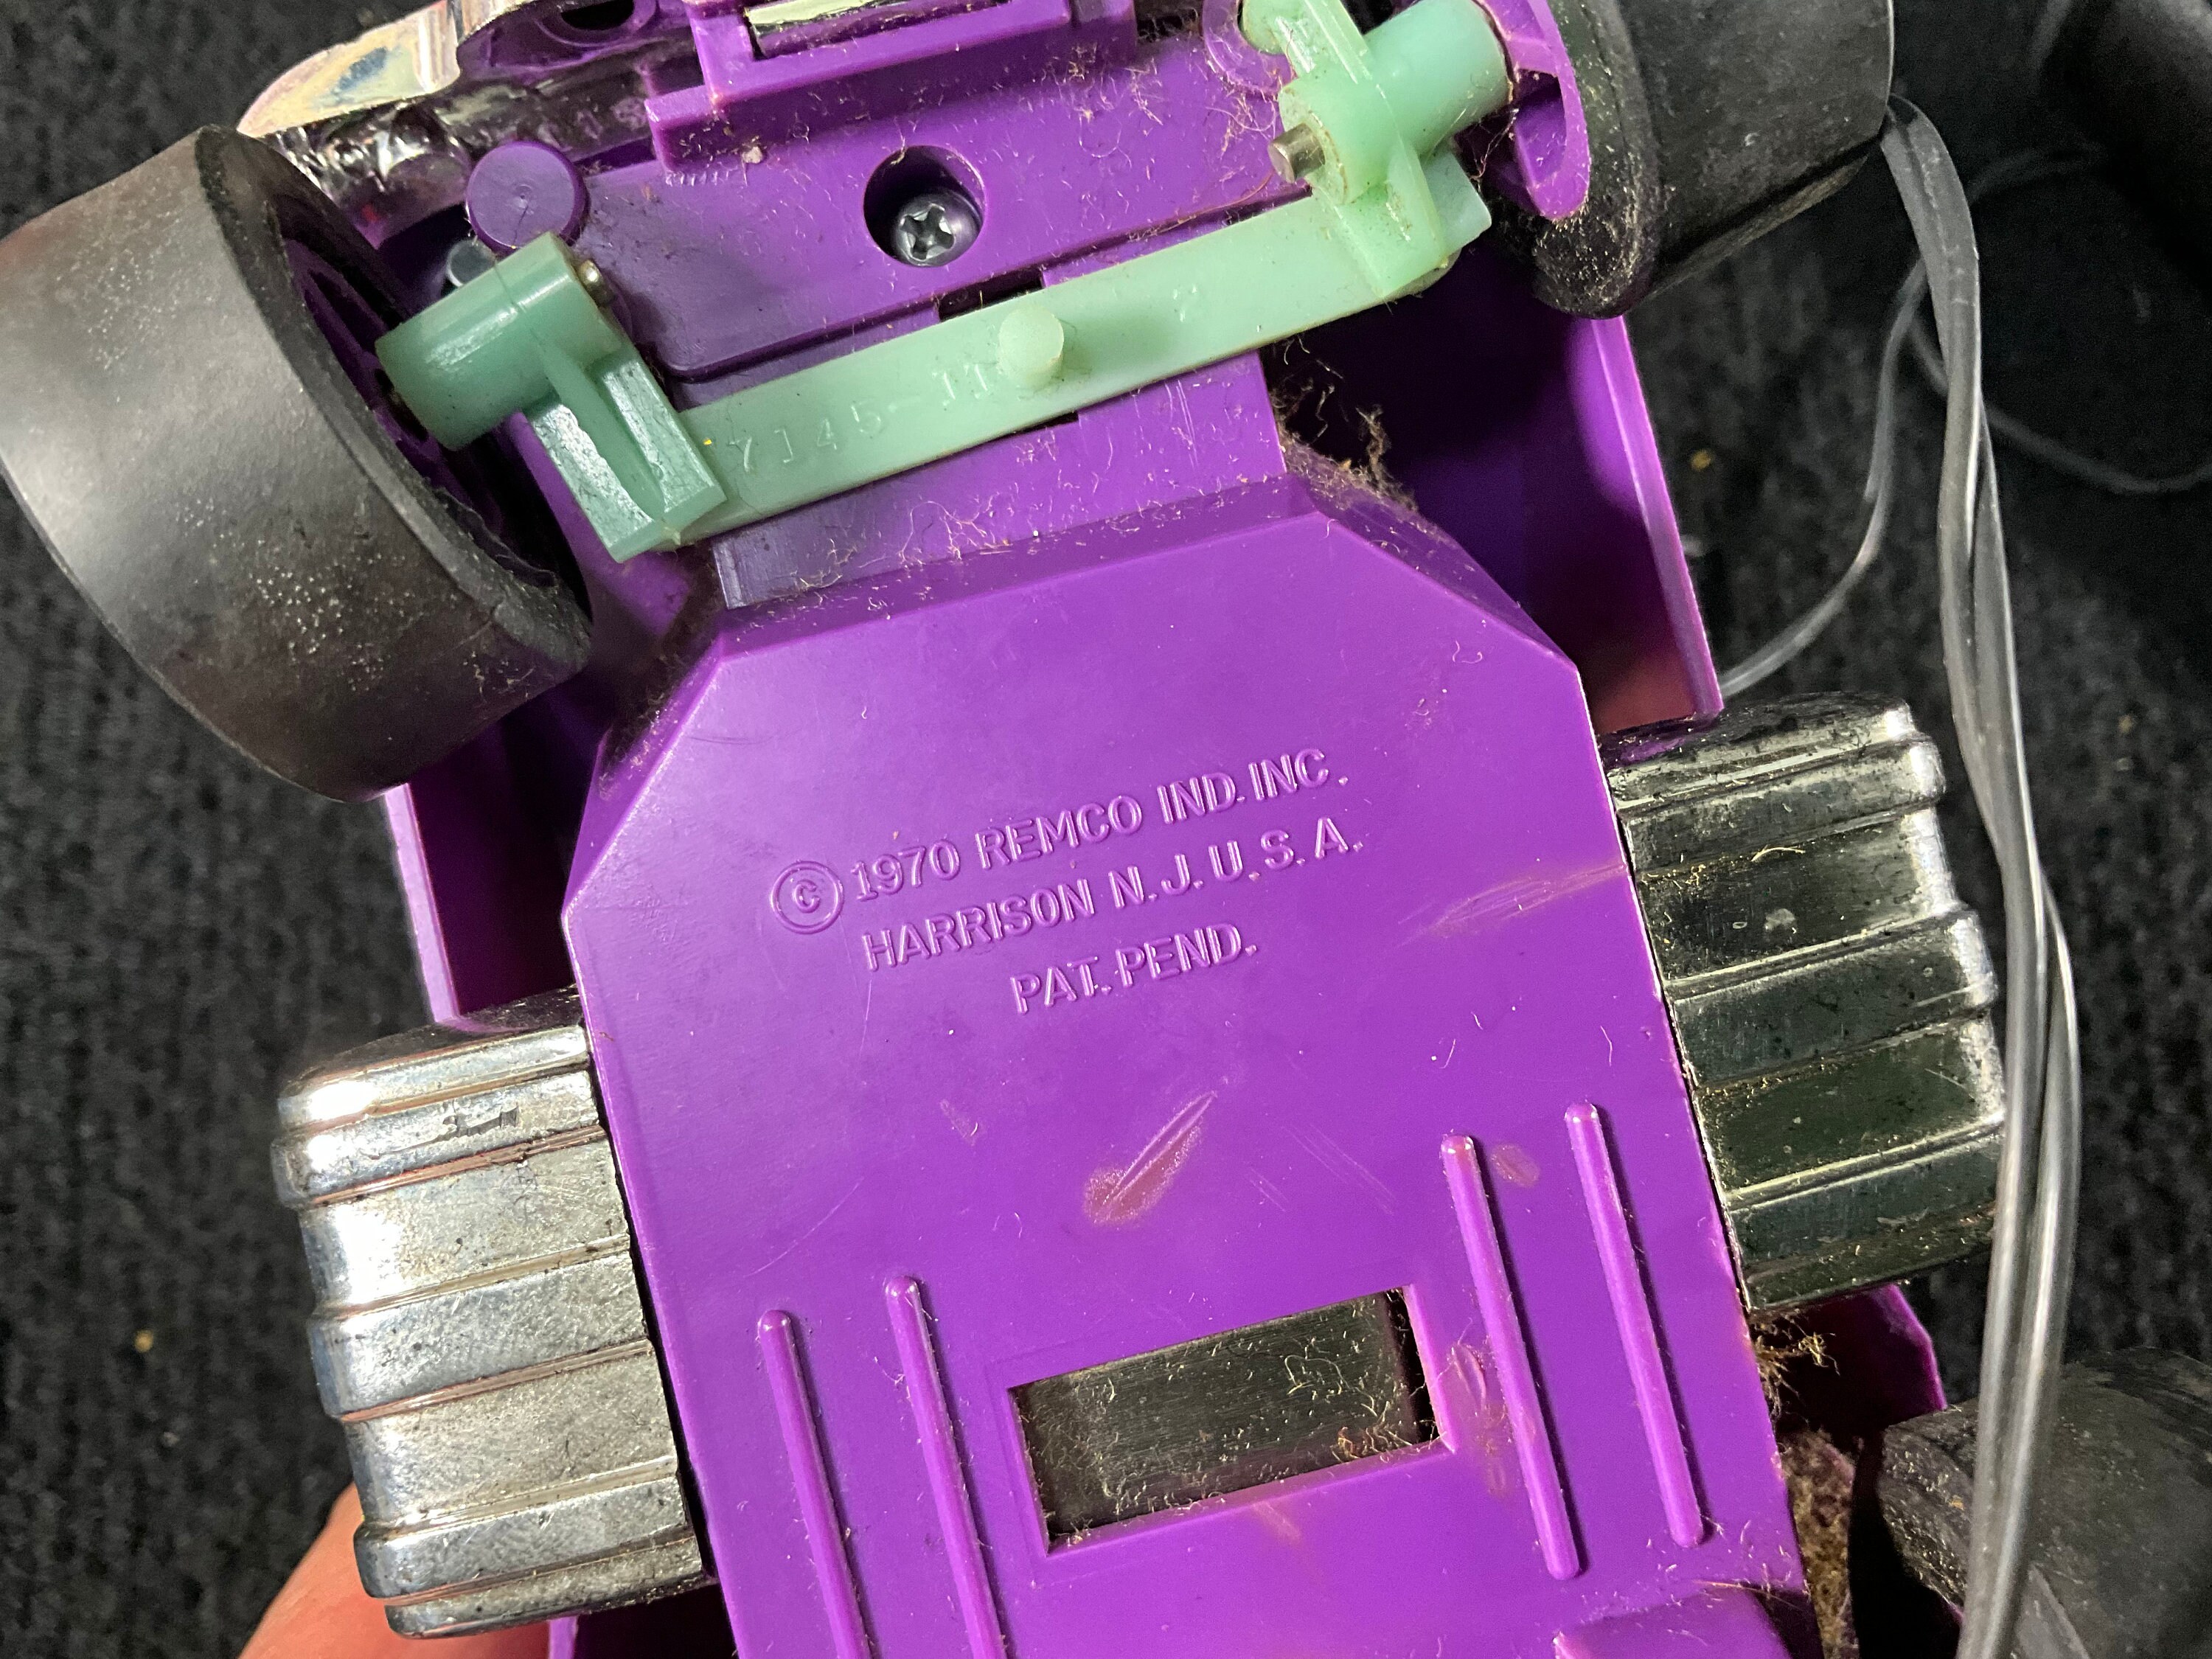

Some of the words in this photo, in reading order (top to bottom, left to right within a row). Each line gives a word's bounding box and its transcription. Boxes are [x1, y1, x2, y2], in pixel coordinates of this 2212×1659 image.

[849, 838, 961, 902] 1970
[974, 795, 1143, 870] REMCO
[861, 878, 1096, 972] HARRISON
